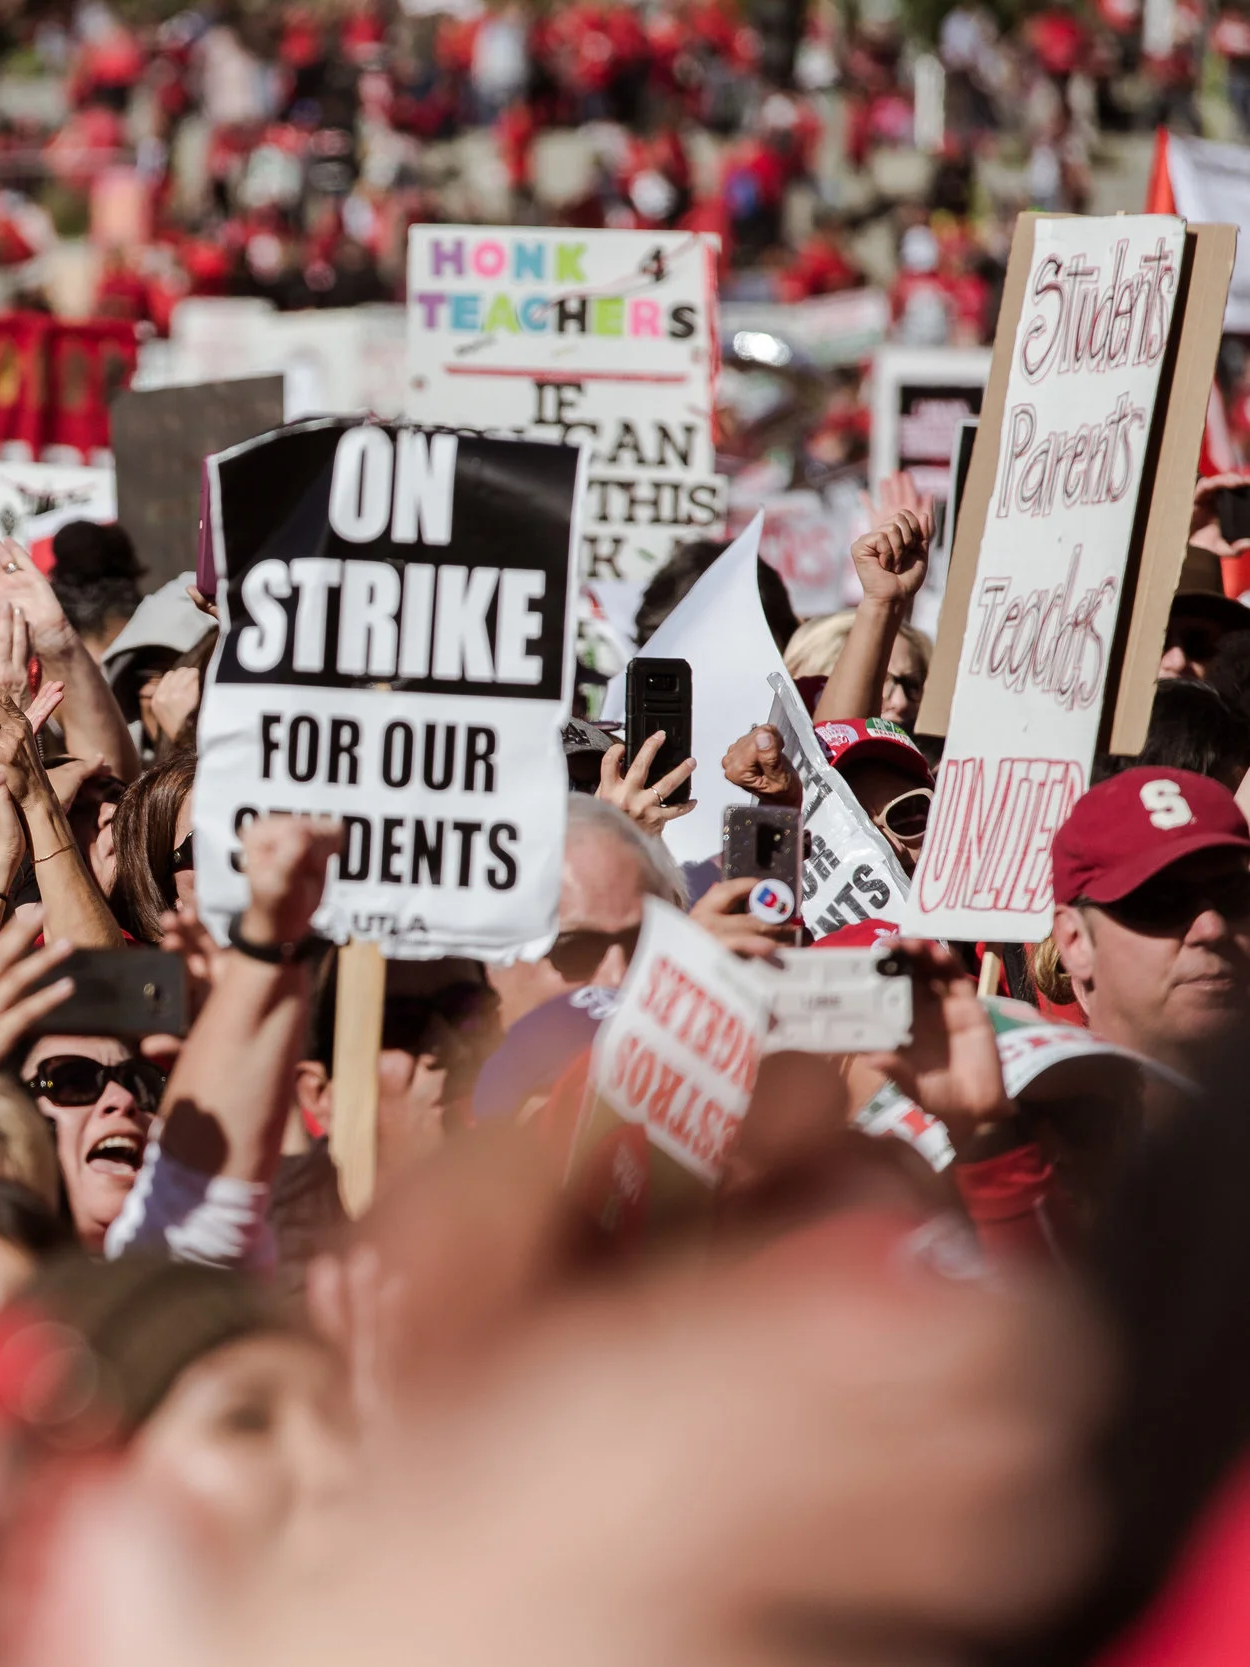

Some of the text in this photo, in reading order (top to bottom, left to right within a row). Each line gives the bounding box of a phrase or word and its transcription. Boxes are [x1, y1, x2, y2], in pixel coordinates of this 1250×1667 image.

[430, 239, 669, 283] HONK 4
[414, 293, 697, 339] TEACHERS
[1020, 237, 1177, 386] Students
[534, 380, 584, 426] IF
[328, 424, 458, 546] ON
[996, 391, 1147, 520] Parents
[587, 478, 720, 526] THIS
[236, 556, 547, 686] STRIKE
[260, 712, 499, 794] FOR OUR
[1139, 779, 1193, 831] S
[639, 956, 760, 1096] NGELES
